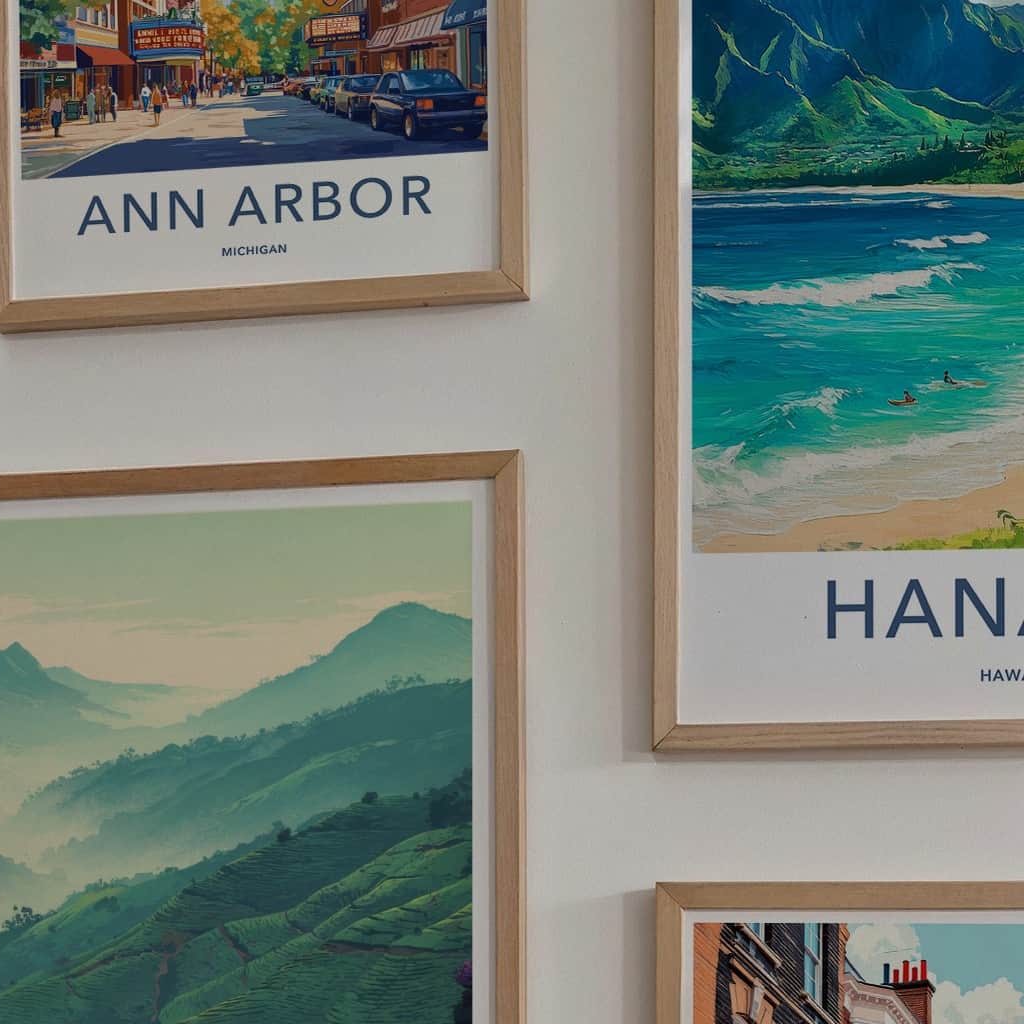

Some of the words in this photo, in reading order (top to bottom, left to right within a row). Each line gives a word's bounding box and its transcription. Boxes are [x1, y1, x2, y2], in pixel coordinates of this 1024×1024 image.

[77, 189, 204, 236] ANN
[228, 175, 432, 227] ARBOR
[221, 243, 288, 257] MICHIGAN
[826, 577, 1024, 639] HAN
[980, 668, 1024, 682] HAW
